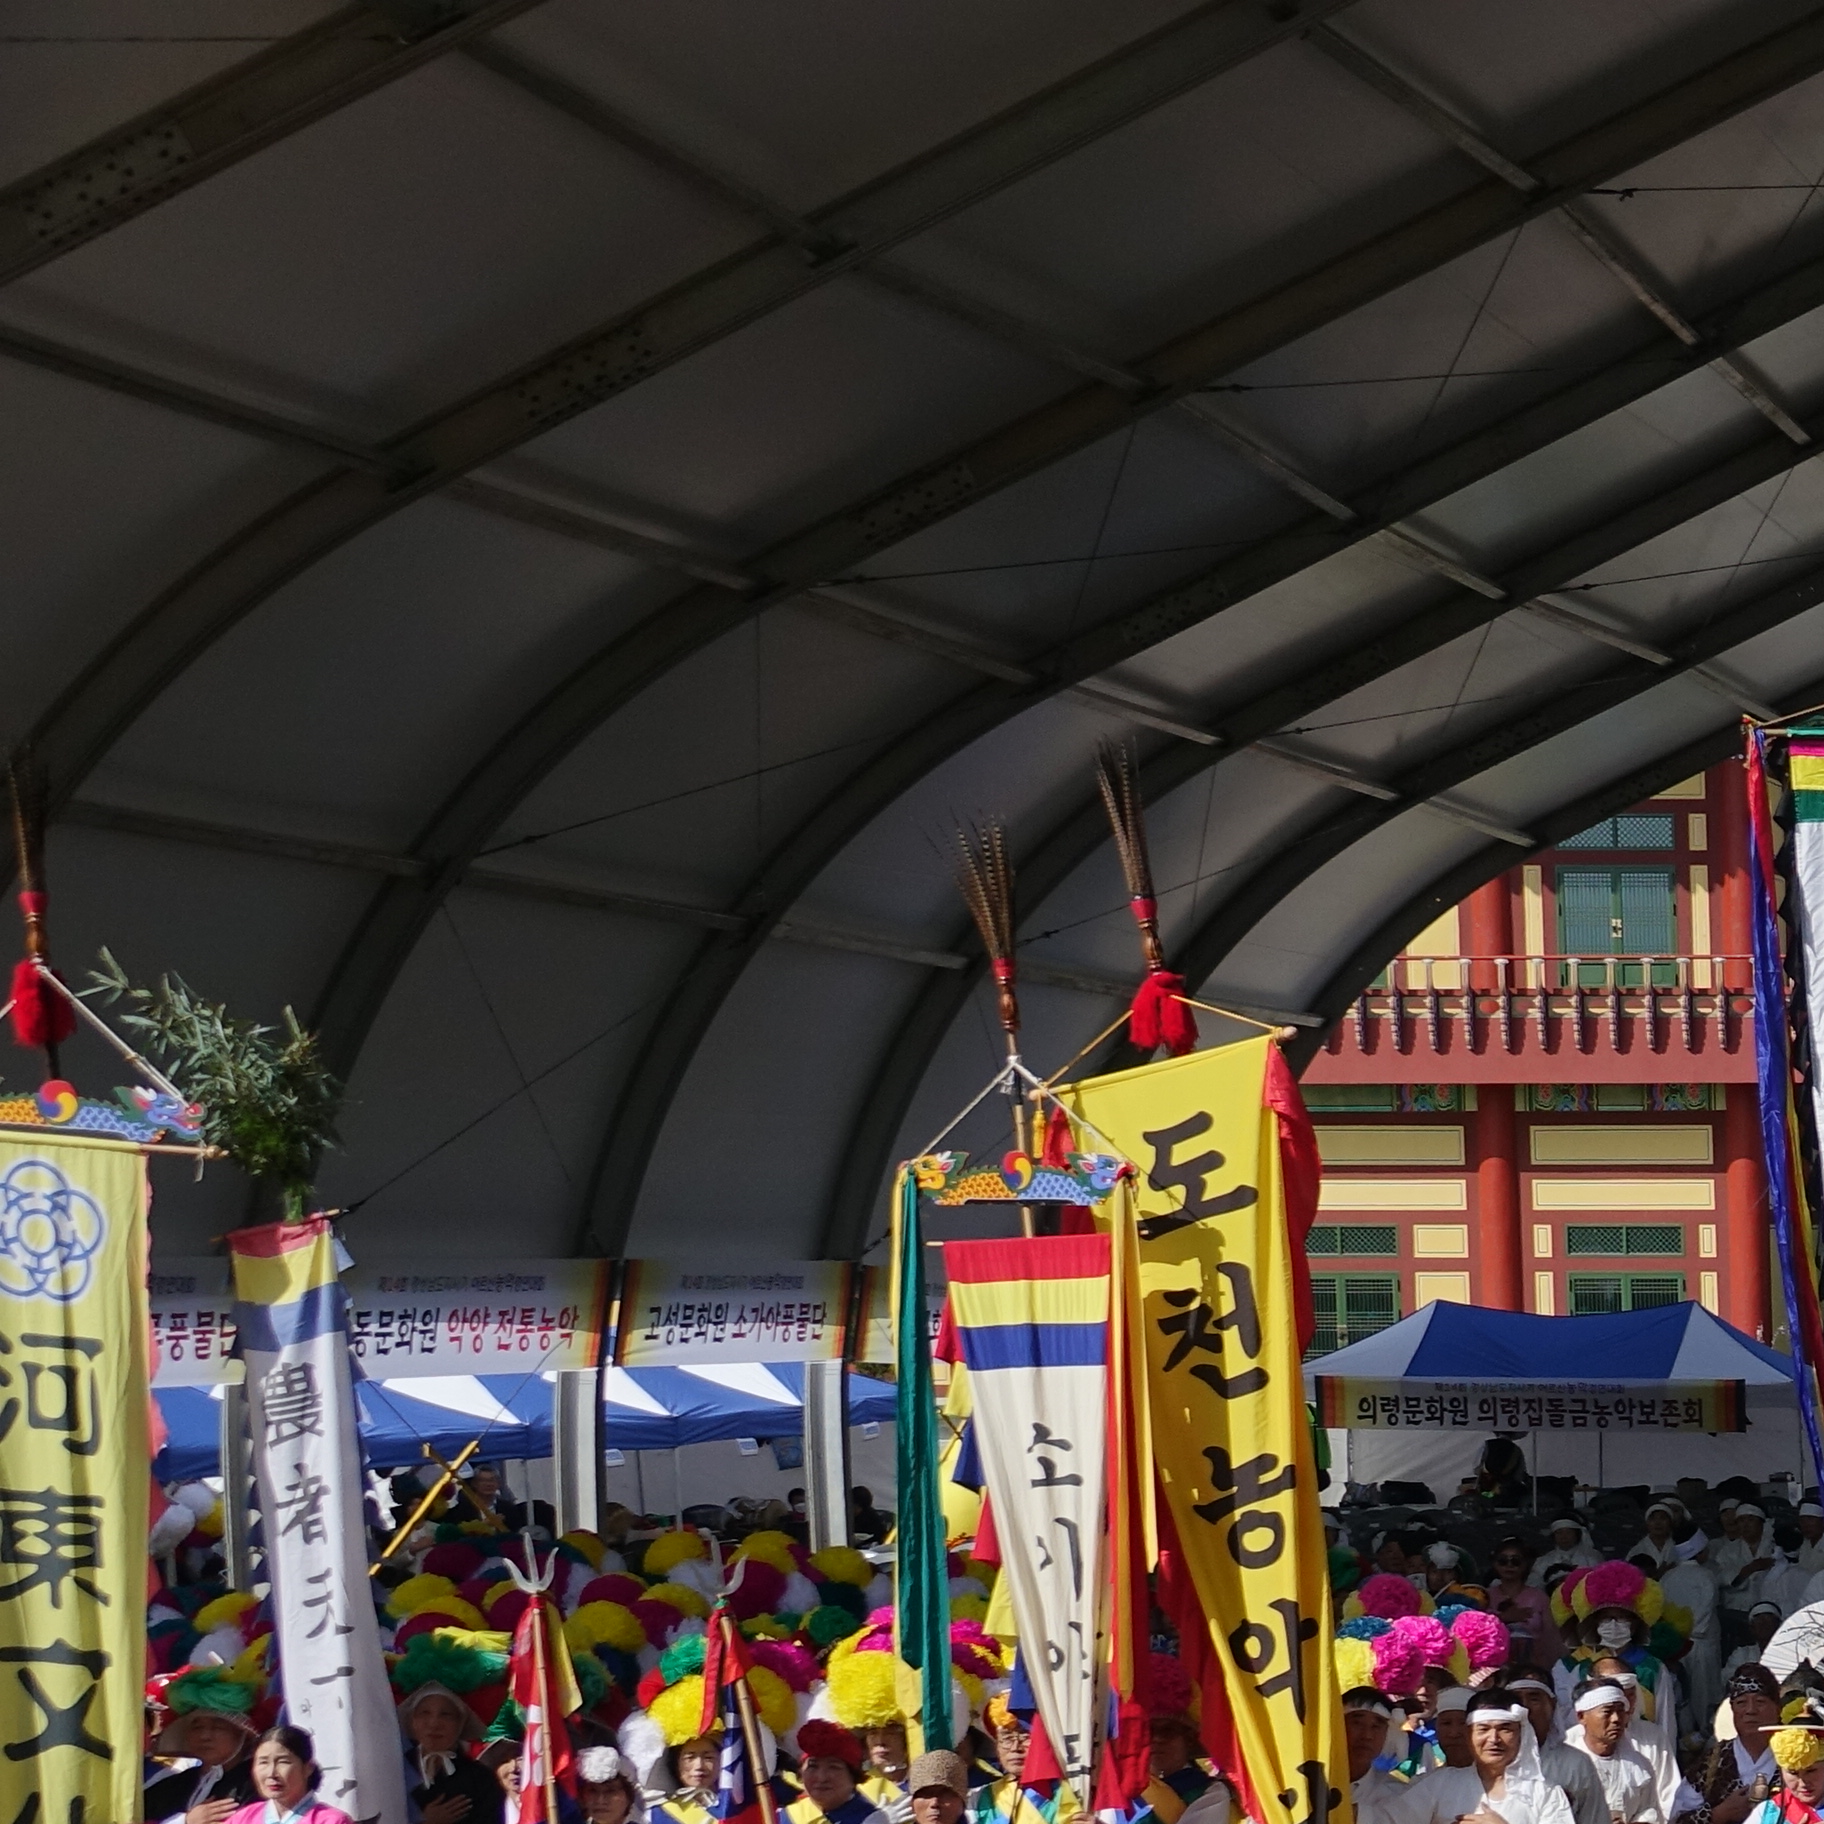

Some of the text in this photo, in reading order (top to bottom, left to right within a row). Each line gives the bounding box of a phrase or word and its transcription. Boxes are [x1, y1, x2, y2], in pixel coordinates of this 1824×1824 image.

[350, 1304, 580, 1357] 동문화원 악양 전통농악
[644, 1300, 828, 1345] 고성문화원 소가야풍물단
[1356, 1394, 1704, 1429] 의령문화원 의령집돌금농악보존회
